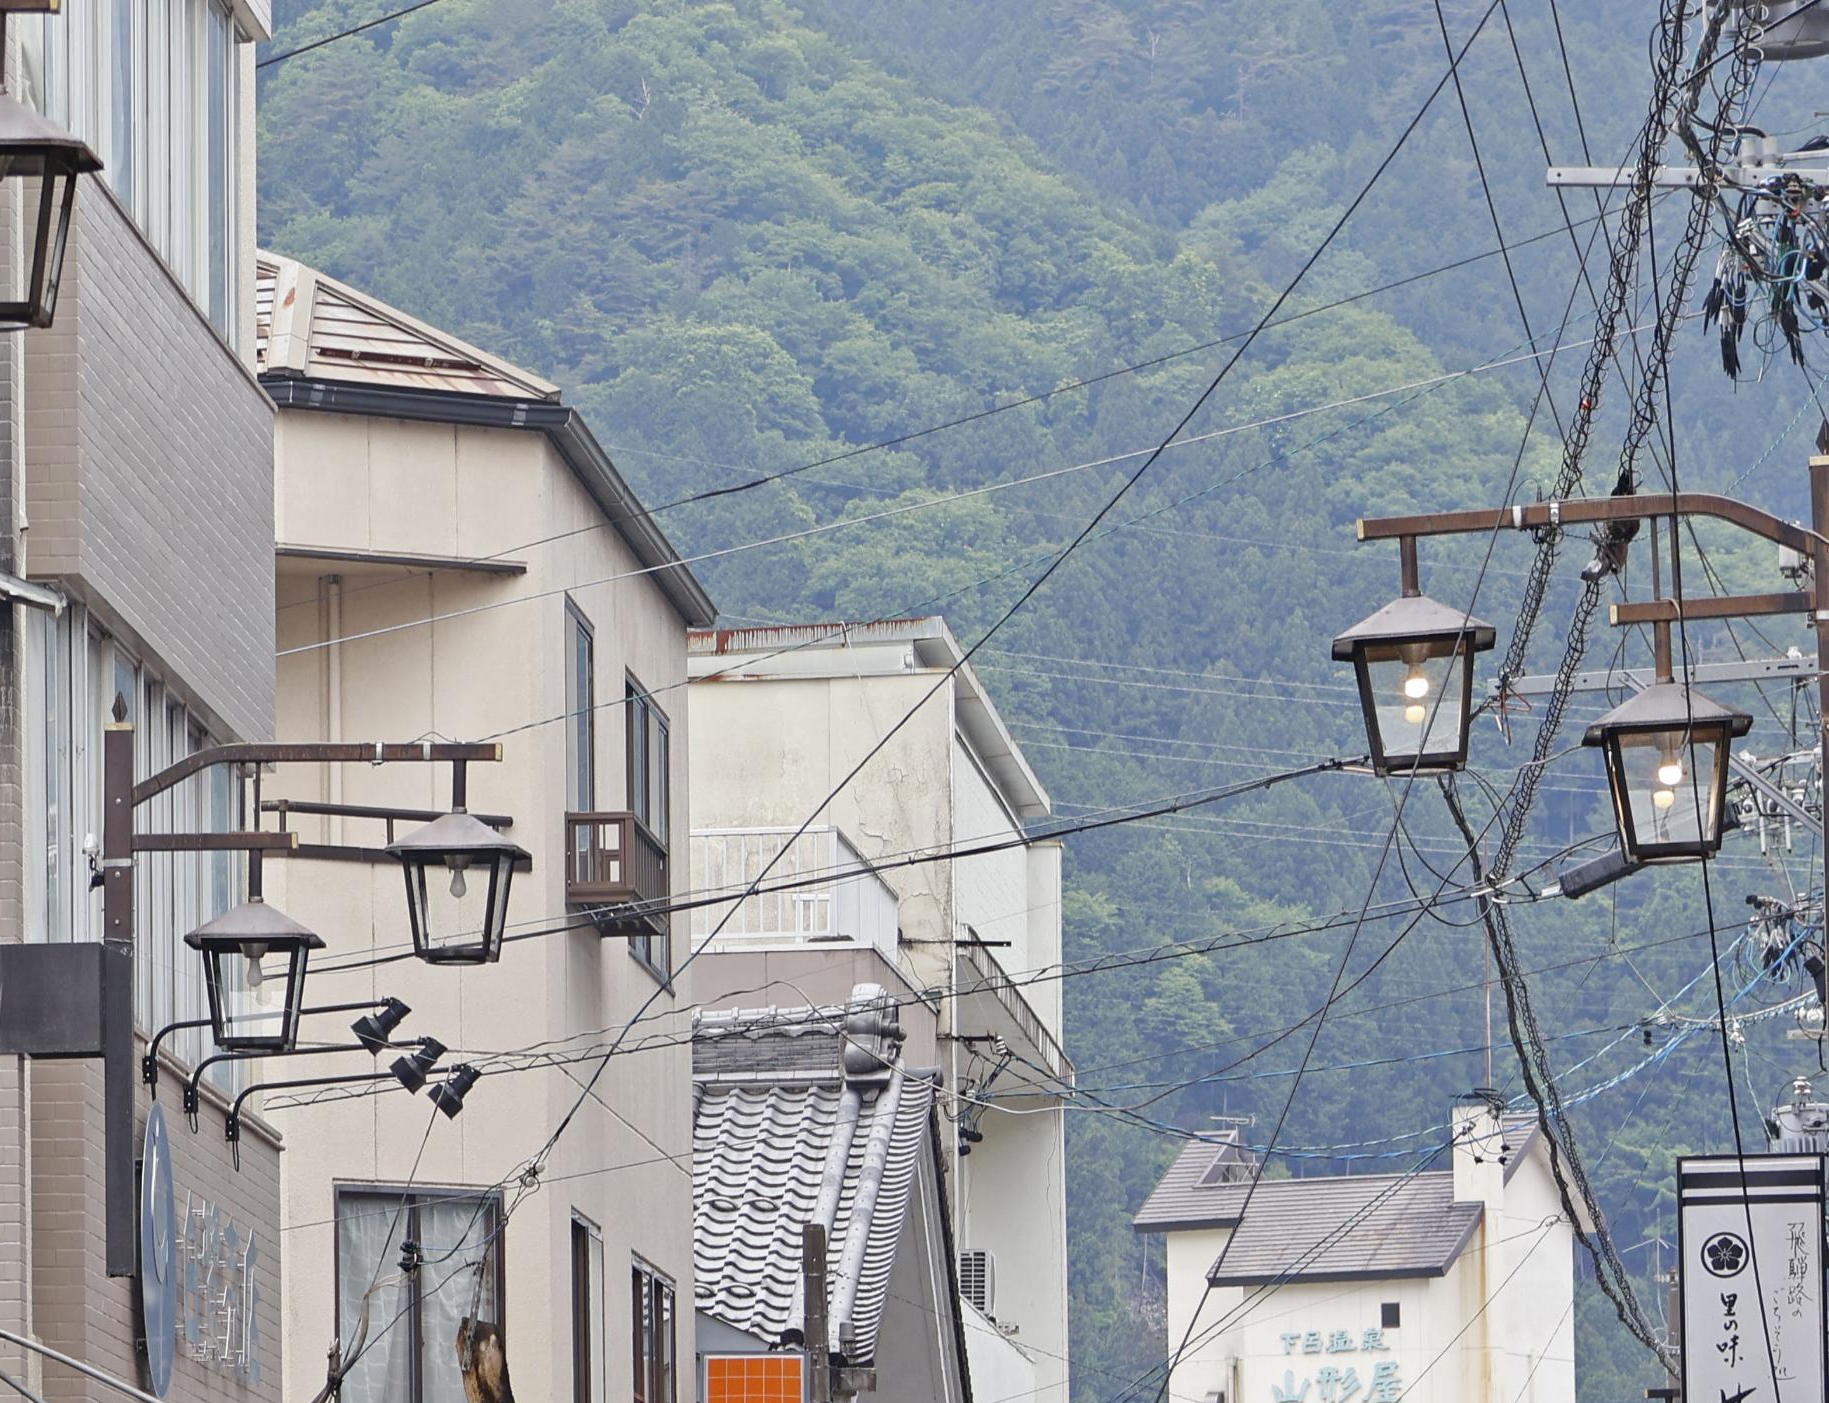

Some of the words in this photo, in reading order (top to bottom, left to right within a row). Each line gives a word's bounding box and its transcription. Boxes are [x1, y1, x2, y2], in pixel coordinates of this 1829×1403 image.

[1280, 1328, 1390, 1356] 下呂温泉
[1716, 1292, 1743, 1368] 里の味
